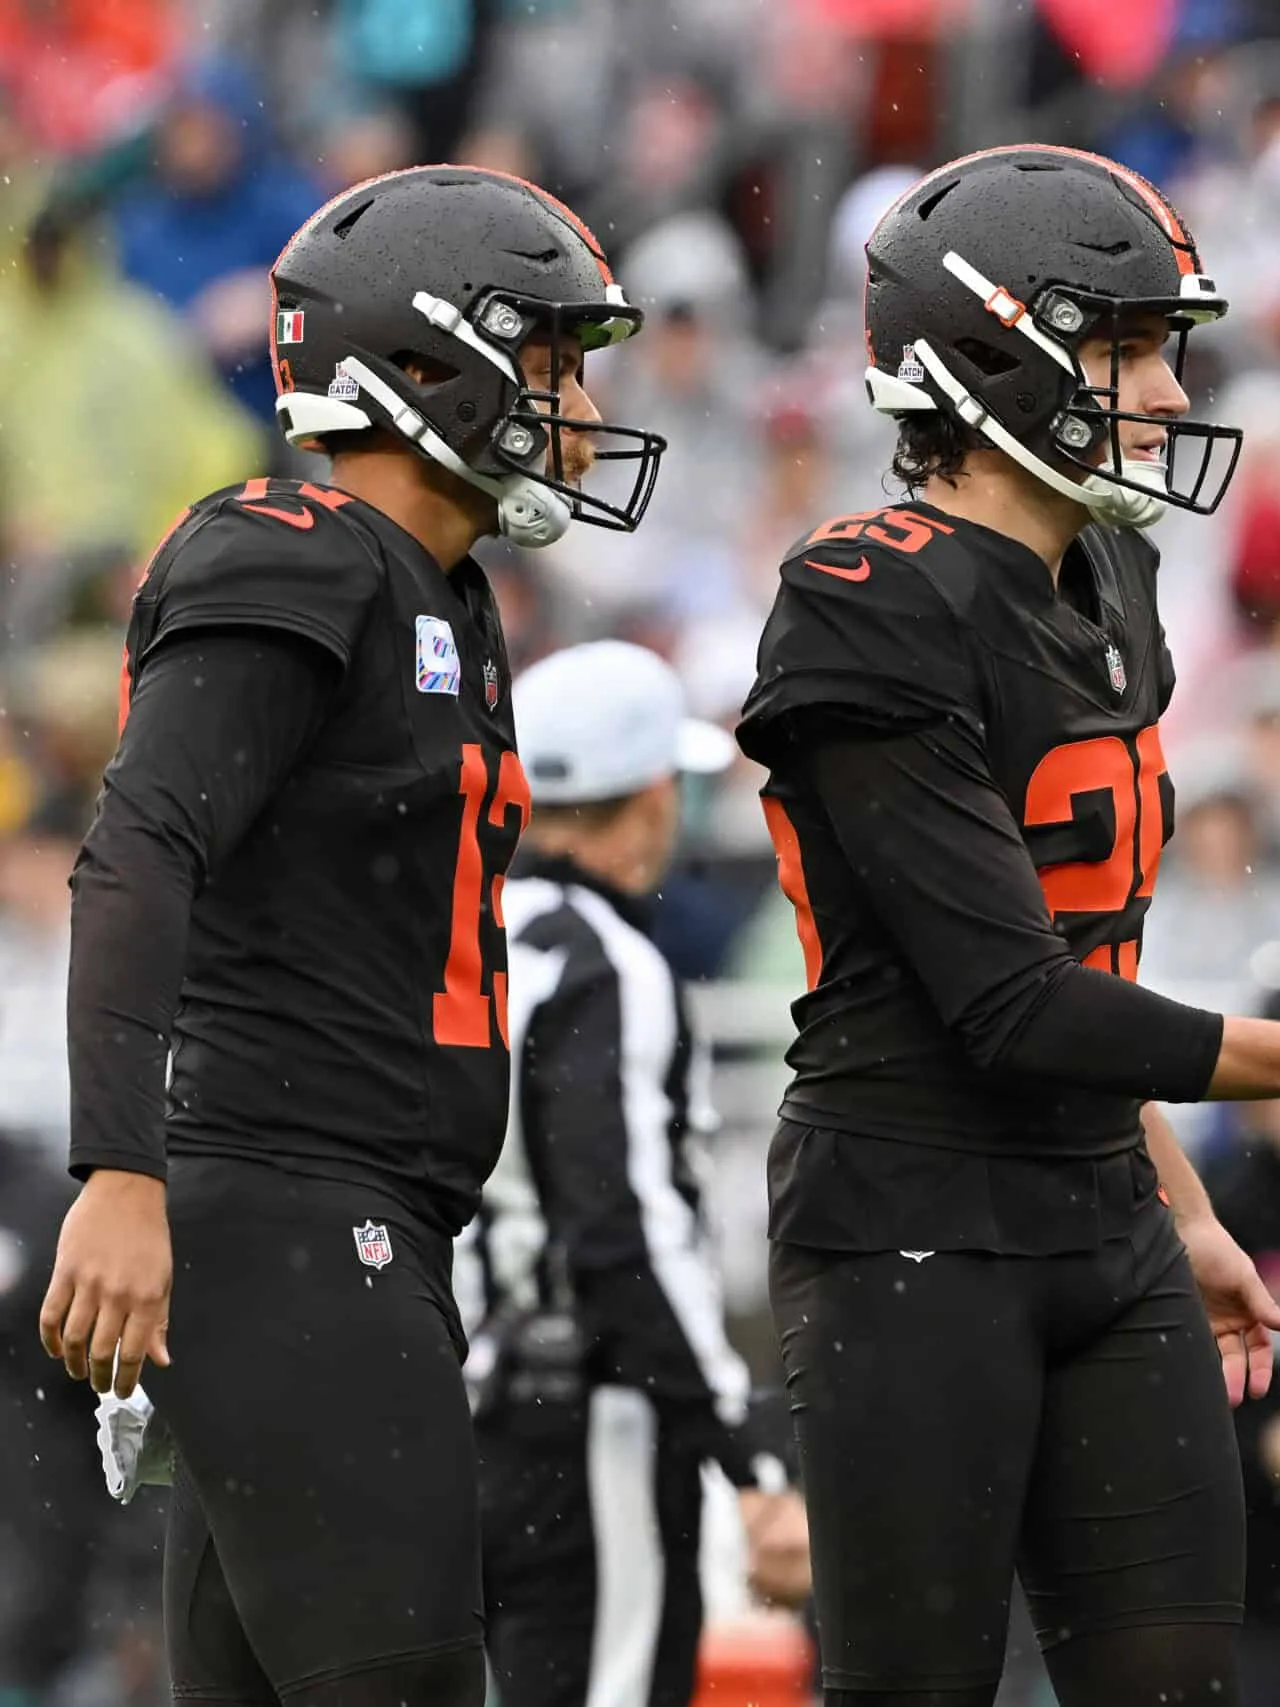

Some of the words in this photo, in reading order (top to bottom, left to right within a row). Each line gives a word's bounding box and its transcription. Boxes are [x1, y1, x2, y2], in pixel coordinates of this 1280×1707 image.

[900, 367, 923, 377] CATCH
[330, 384, 359, 395] CATCH
[805, 508, 956, 552] 25
[362, 1243, 389, 1261] NFL
